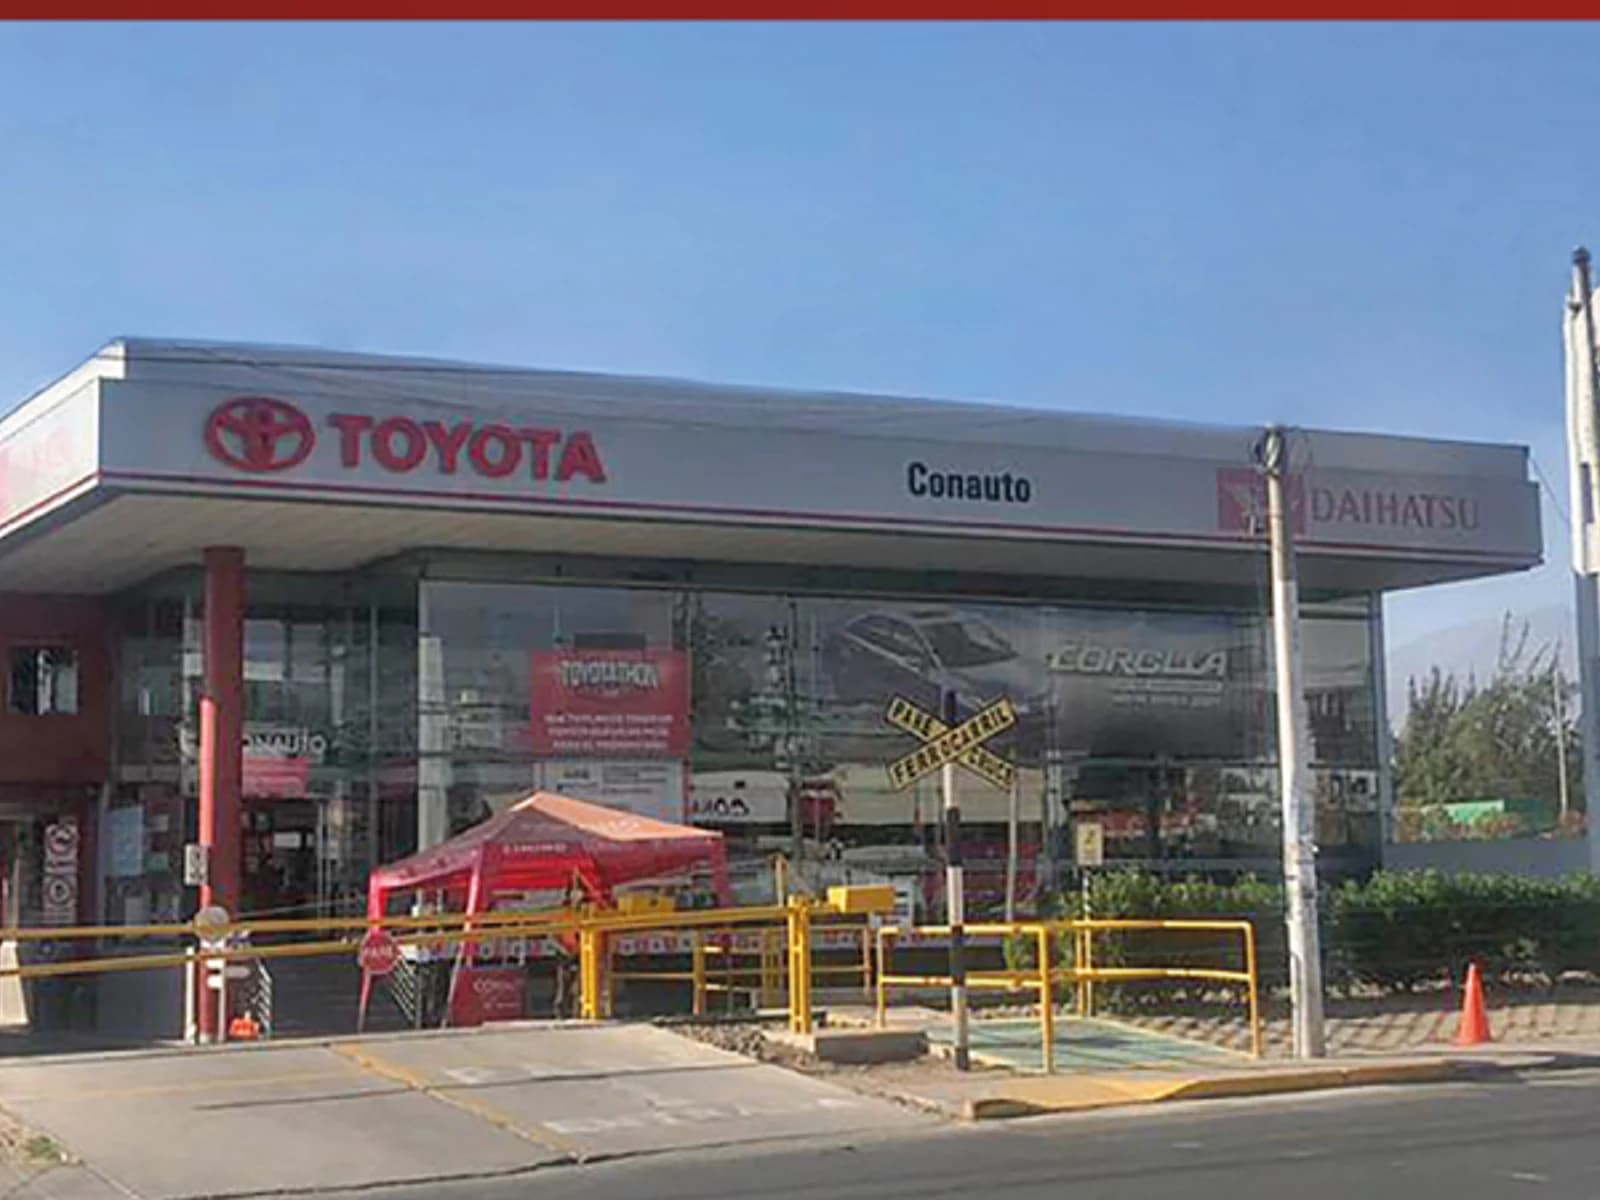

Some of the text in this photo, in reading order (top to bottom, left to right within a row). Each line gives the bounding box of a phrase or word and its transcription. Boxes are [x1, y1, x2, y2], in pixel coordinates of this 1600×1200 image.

[327, 412, 607, 484] TOYOTA
[907, 461, 1032, 503] Conauto
[1310, 486, 1480, 531] DAIHATSU
[892, 704, 1010, 784] FERROCARRIL
